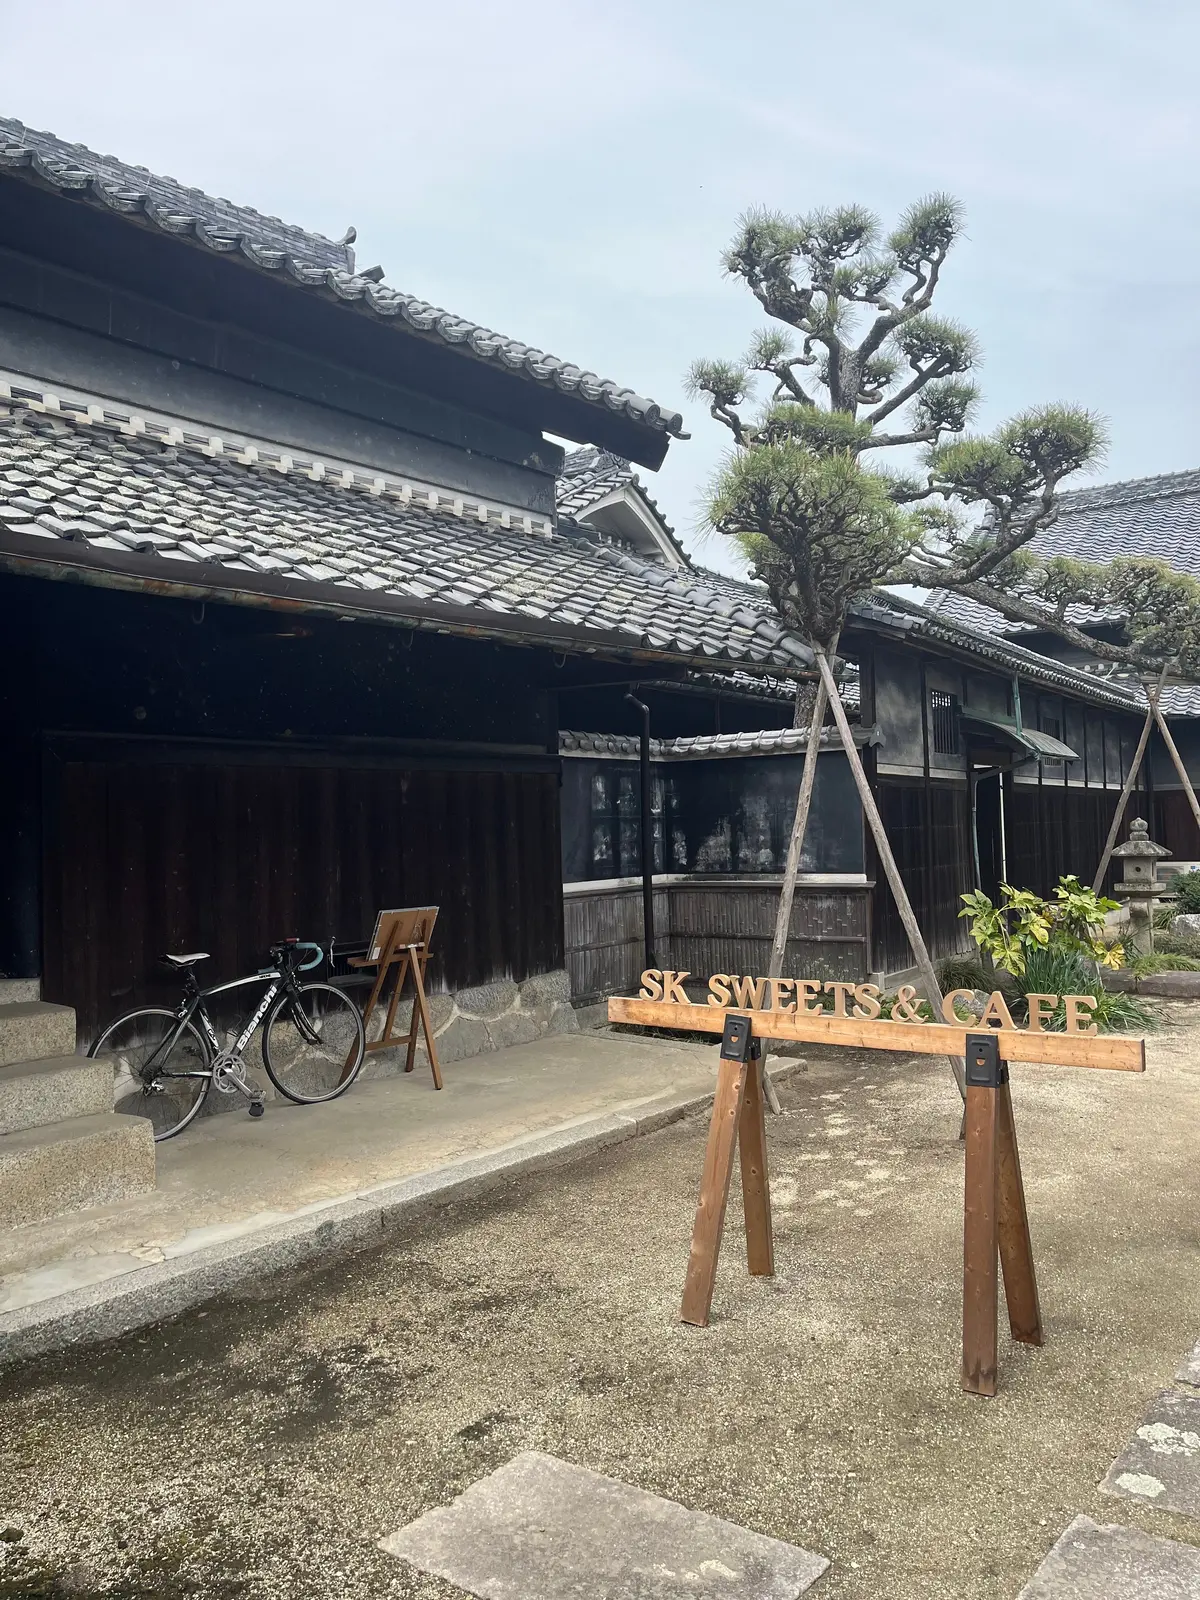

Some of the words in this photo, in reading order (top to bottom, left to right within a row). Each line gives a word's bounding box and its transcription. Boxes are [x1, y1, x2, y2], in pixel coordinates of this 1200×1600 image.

[236, 984, 277, 1051] Bianchi
[639, 969, 691, 1004] SK
[707, 974, 881, 1020] SWEETS
[891, 985, 929, 1024] &
[942, 989, 1098, 1036] CAFE
